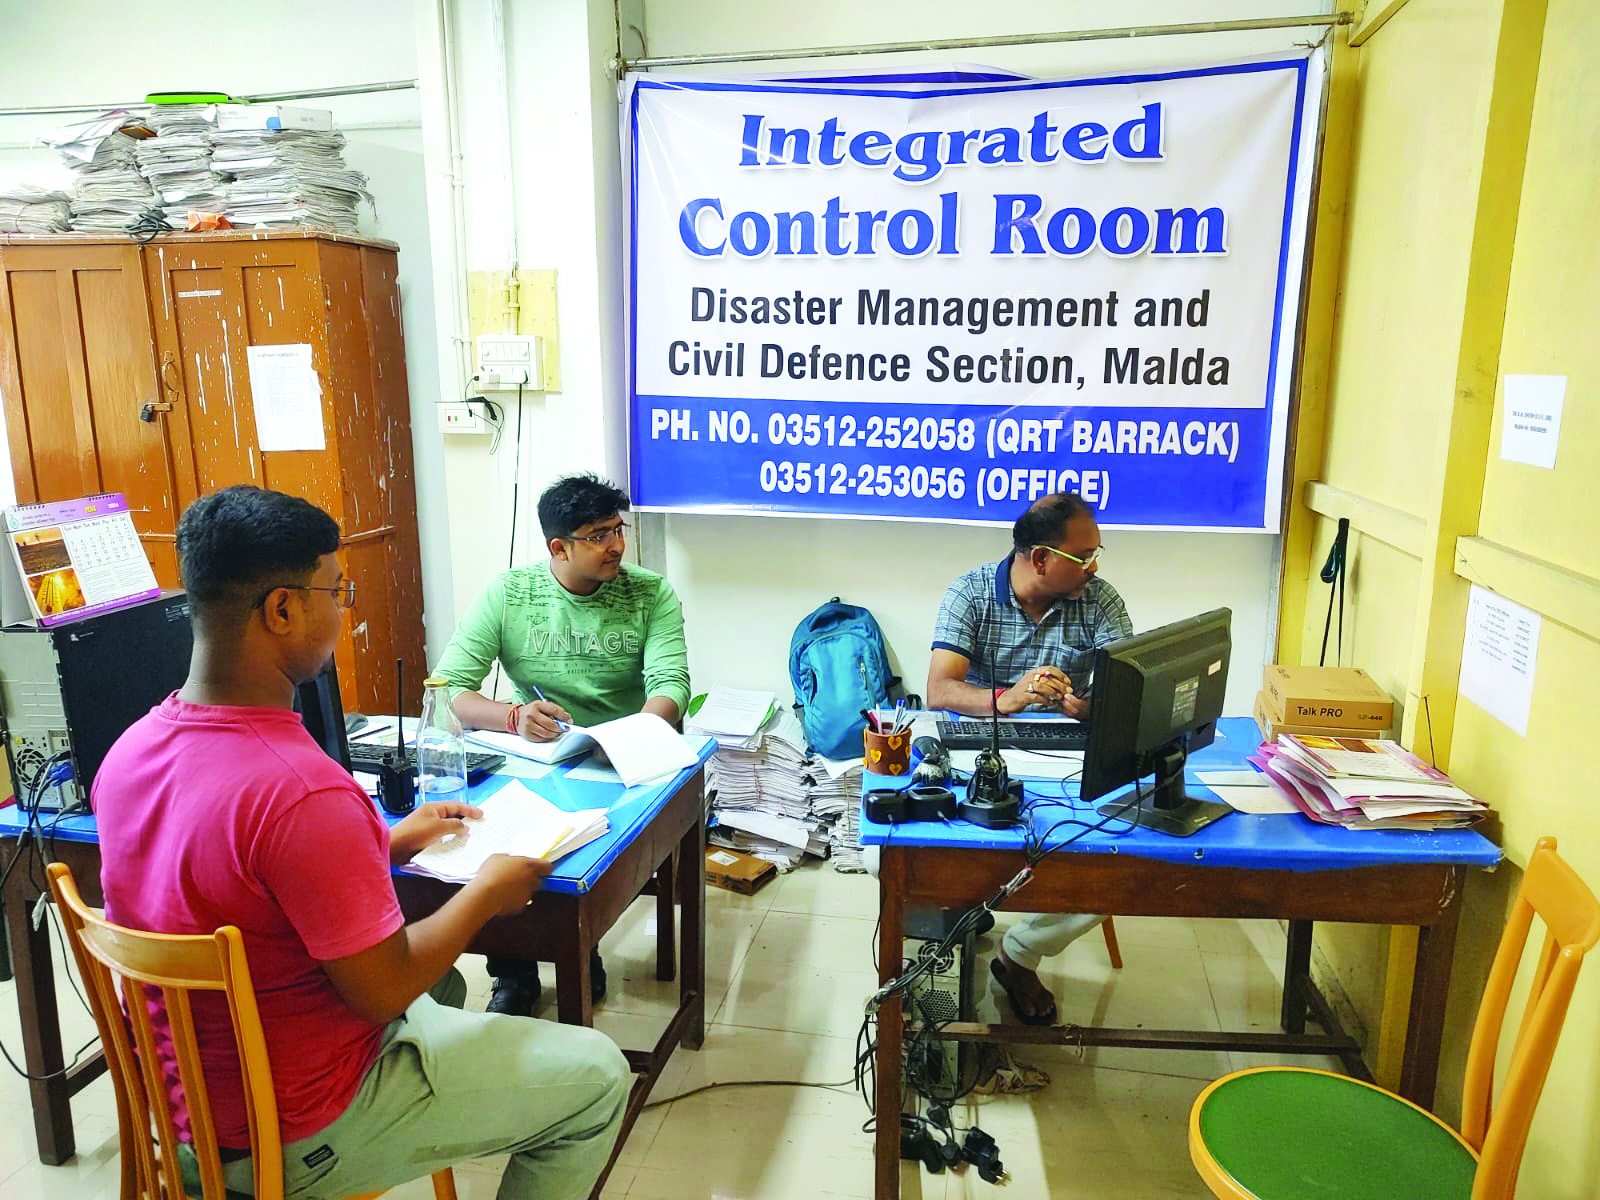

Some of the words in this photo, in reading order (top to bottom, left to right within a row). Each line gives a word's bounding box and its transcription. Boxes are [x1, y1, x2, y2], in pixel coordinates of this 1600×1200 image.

[739, 102, 1164, 182] Integrated
[678, 192, 960, 257] Control
[990, 193, 1226, 255] Room
[691, 287, 843, 325] Disaster
[857, 289, 1119, 335] Management
[1134, 289, 1210, 328] and
[668, 340, 745, 379] Civil
[760, 343, 910, 382] Defence
[926, 345, 1085, 391] Section,
[1103, 347, 1230, 386] Malda
[651, 408, 699, 442] PH.
[709, 410, 759, 445] NO.
[768, 414, 976, 451] 03512-252058
[986, 418, 1059, 461] (QRT
[1071, 421, 1239, 464] BARRACK)
[760, 461, 966, 499] 03512-253056
[976, 467, 1110, 510] (OFFICE)
[531, 625, 639, 656] VINTAGE
[1296, 706, 1317, 716] Talk
[1319, 708, 1343, 718] PRO
